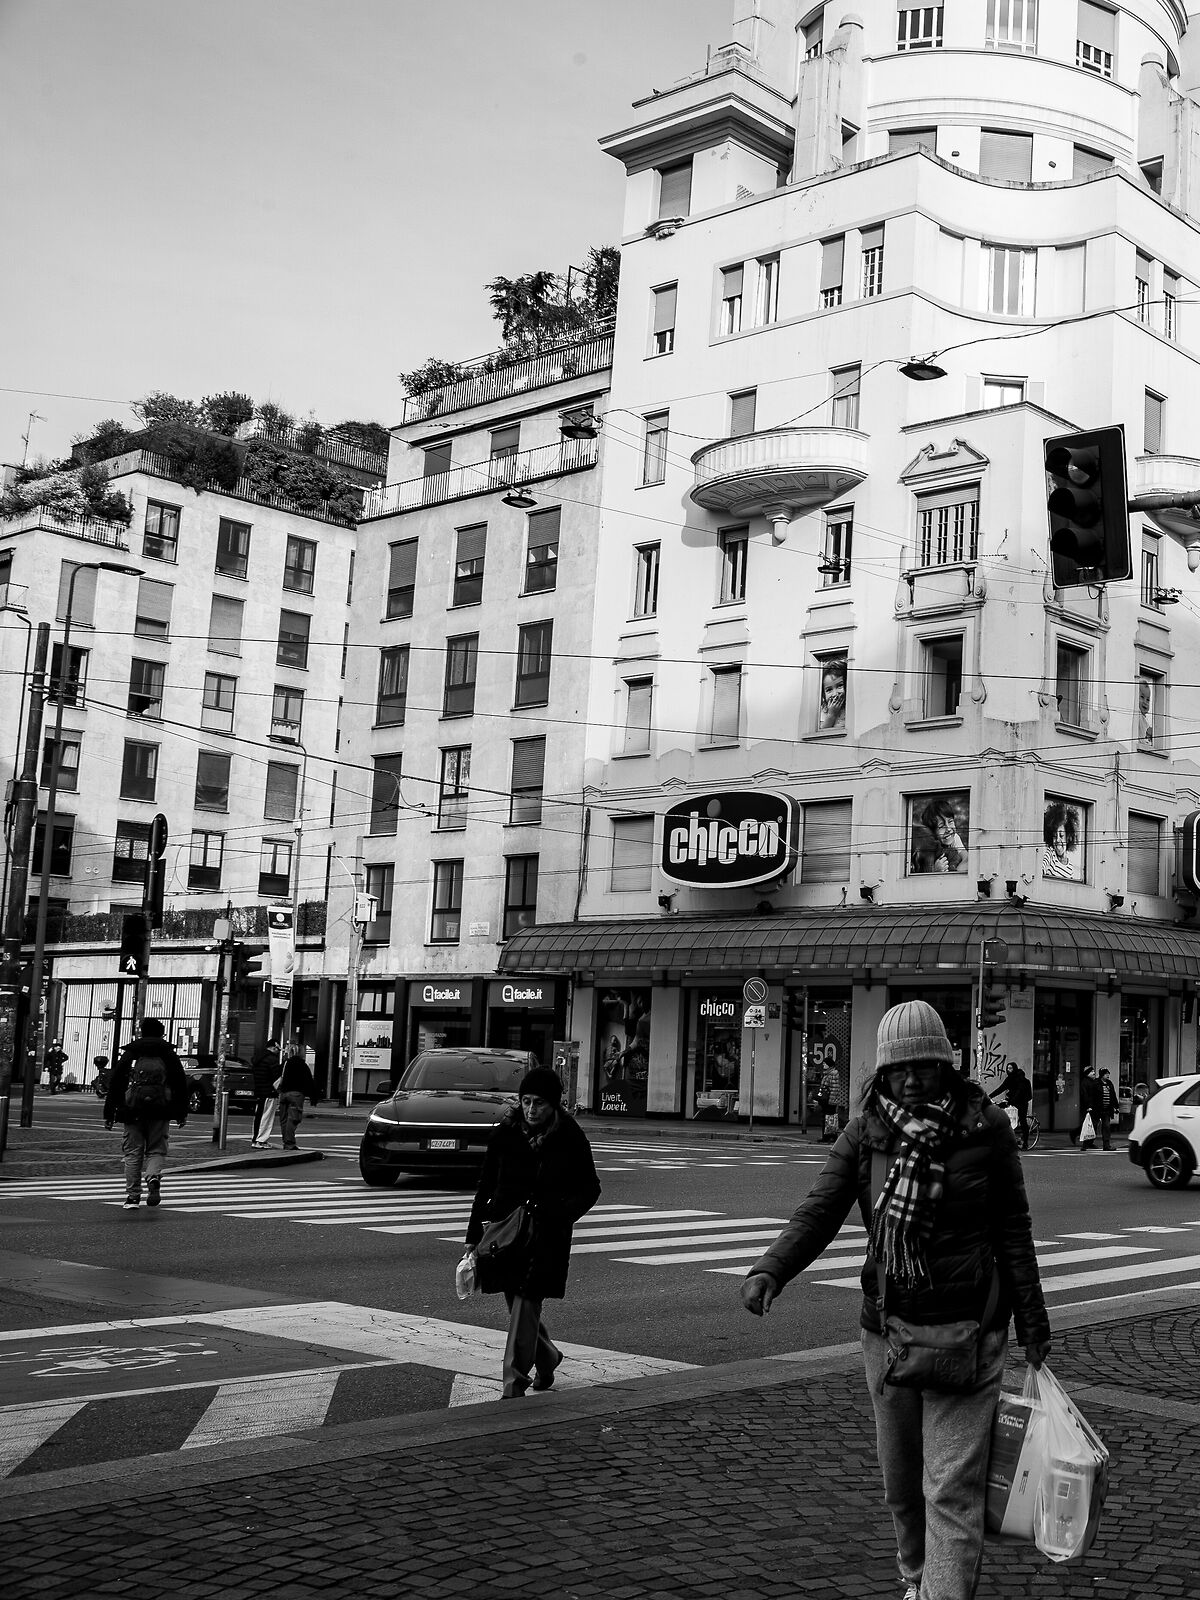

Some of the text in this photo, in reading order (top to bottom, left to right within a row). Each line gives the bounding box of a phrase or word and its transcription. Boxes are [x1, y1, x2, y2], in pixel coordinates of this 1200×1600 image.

[669, 799, 779, 866] chicco
[434, 988, 460, 1000] facile.it
[514, 988, 543, 1000] facile.it
[700, 995, 735, 1017] chicco
[601, 1092, 616, 1102] Live
[601, 1101, 620, 1111] Love
